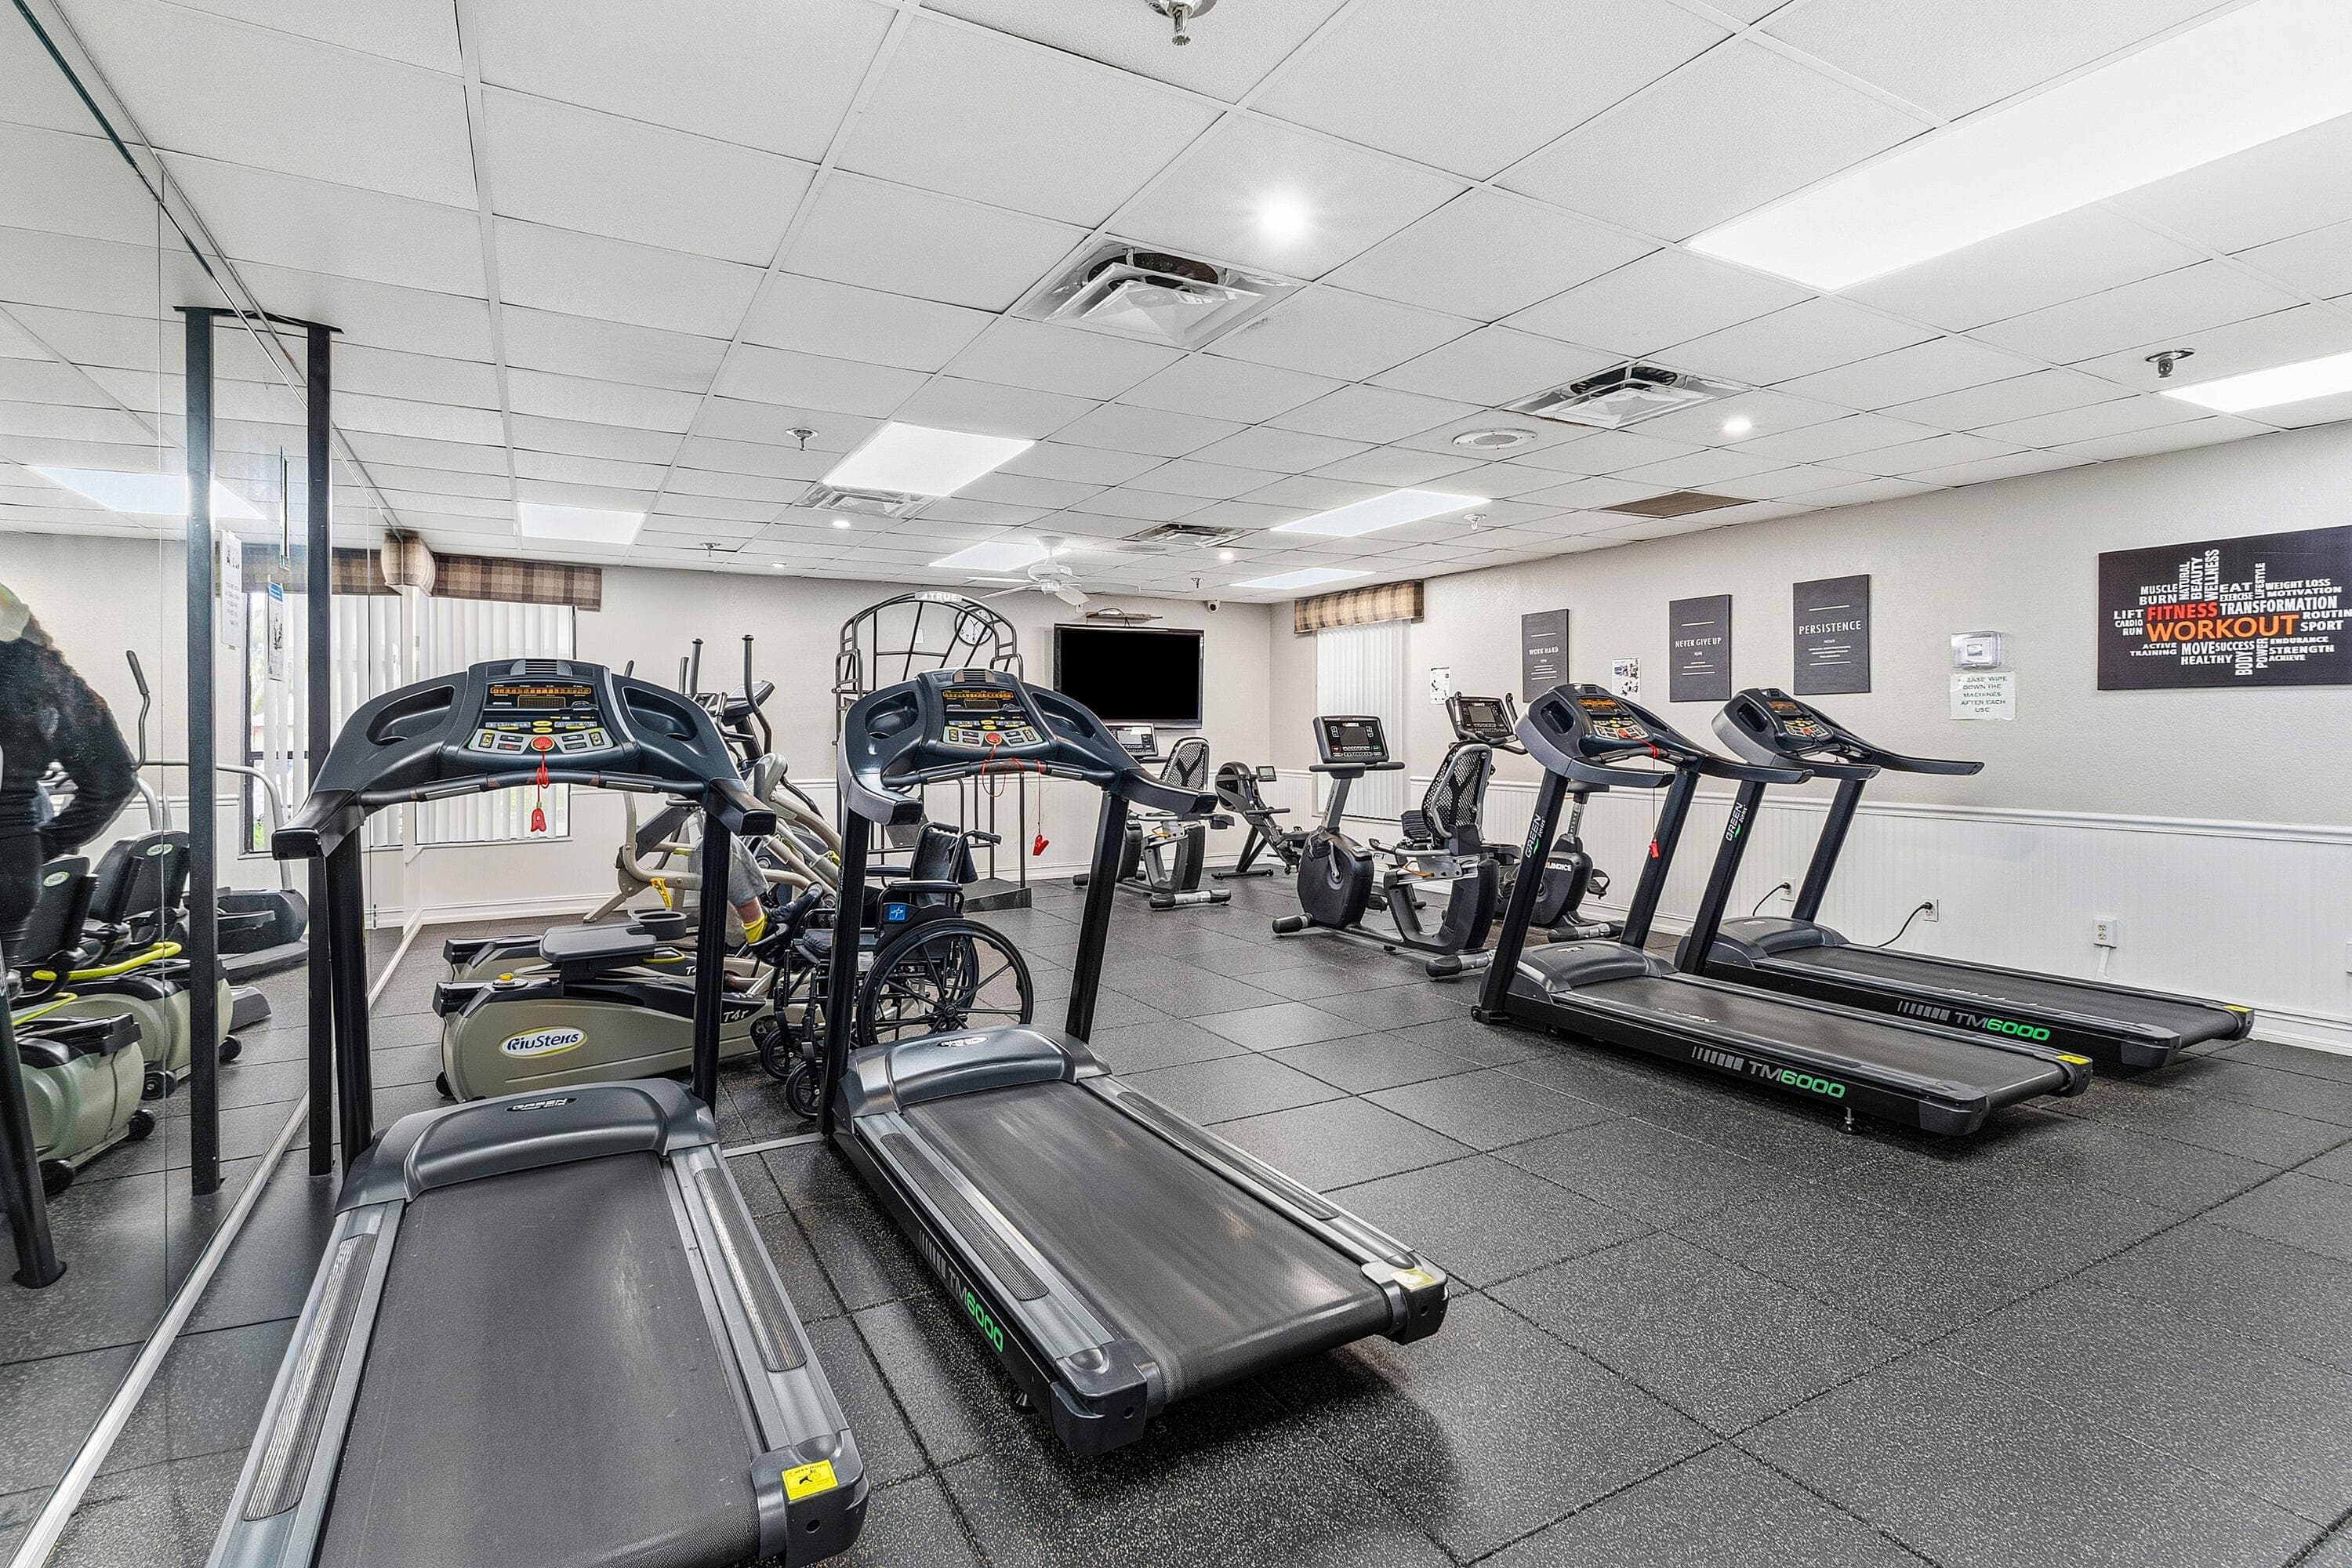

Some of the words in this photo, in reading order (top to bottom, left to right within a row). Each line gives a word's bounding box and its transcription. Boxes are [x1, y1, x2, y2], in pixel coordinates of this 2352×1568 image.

[2179, 561, 2190, 601] NATURAL
[2190, 557, 2203, 601] BEAUTY
[2204, 549, 2220, 602] WELLNESS
[2255, 562, 2266, 599] LIFESTYLE
[2140, 583, 2178, 595] MUSCLE
[2220, 582, 2253, 593] EAT
[2265, 580, 2304, 590] WEIGHT
[2306, 578, 2331, 588] LOSS
[2220, 592, 2254, 601] EXERCISE
[2267, 586, 2343, 597] MOTIVATION
[2139, 593, 2177, 605] BURN
[2220, 595, 2338, 615] TRANSFORMATION
[2114, 608, 2144, 620] LIFT
[2147, 601, 2218, 621] FITNESS
[2303, 608, 2352, 619] ROUTIN
[1798, 620, 1862, 635] PERSISTENCE
[2114, 619, 2143, 628] CARDIO
[2146, 614, 2299, 642] WORKOUT
[2299, 620, 2344, 632] SPORT
[2122, 627, 2143, 636] RUN
[1675, 639, 1695, 648] NEVER
[1696, 637, 1711, 646] GIVE
[1712, 637, 1722, 645] UP
[2215, 641, 2255, 652] SUCCESS
[2270, 636, 2330, 644] ENDURANCE
[2181, 641, 2215, 655] MOVE
[2256, 637, 2269, 669] POWER
[2269, 644, 2336, 655] STRENGTH
[2180, 654, 2233, 666] HEALTHY
[2234, 652, 2253, 676] BODY
[1726, 802, 1743, 841] GREEN
[1525, 813, 1541, 858] GREEN
[1955, 1011, 2051, 1041] TM6000
[1748, 1061, 1846, 1098] TM6000
[949, 1266, 1004, 1353] TM6000
